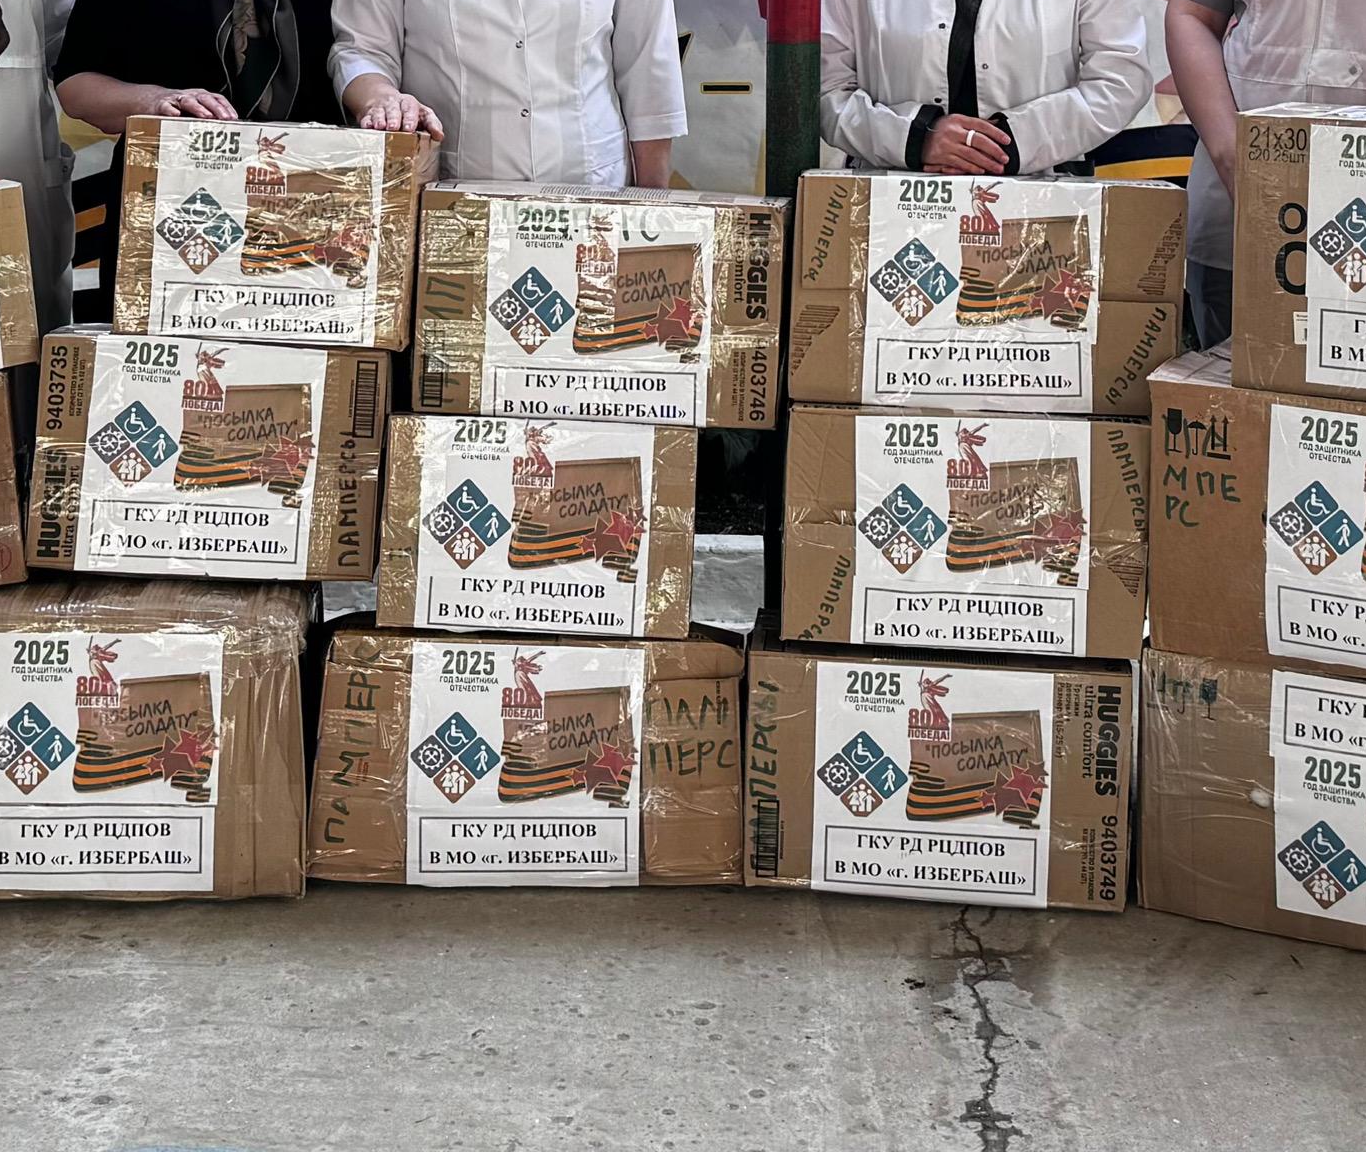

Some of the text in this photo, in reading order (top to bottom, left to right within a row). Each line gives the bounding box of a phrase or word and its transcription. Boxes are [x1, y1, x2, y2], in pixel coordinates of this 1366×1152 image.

[899, 178, 953, 204] 2025
[124, 340, 180, 368] 2025
[1331, 346, 1342, 359] В
[46, 345, 68, 431] 9403735
[749, 340, 768, 422] 403746
[453, 419, 507, 445] 2025
[885, 423, 939, 447] 2025
[1300, 416, 1358, 448] 2025
[124, 507, 270, 530] ГКУ РД РЦДПОВ
[100, 534, 289, 557] В МО «г. ИЗБЕРБАШ»
[896, 597, 1044, 619] ГКУ РД РЦДПОВ
[874, 623, 1065, 646] В МО «г. ИЗБЕРБАШ»
[13, 640, 70, 664] 2025
[441, 650, 496, 676] 2025
[846, 670, 901, 696] 2025
[844, 695, 905, 706] ГОД ЗАЩИТНИКА
[855, 705, 895, 713] ОТЕЧЕСТВА
[908, 729, 950, 740] ПОБЕДА!
[1082, 685, 1094, 779] ultra comfort
[1095, 685, 1121, 797] HUGGIES
[1303, 756, 1361, 789] 2025
[21, 823, 171, 840] ГКУ РД РЦДПОВ
[451, 824, 597, 840] ГКУ РД РЦДПОВ
[15, 852, 46, 865] МО
[51, 855, 73, 865] «г.
[80, 851, 192, 866] ИЗБЕРБАШ»
[430, 850, 618, 865] В МО «г. ИЗБЕРБАШ»
[1099, 815, 1118, 901] 9403749
